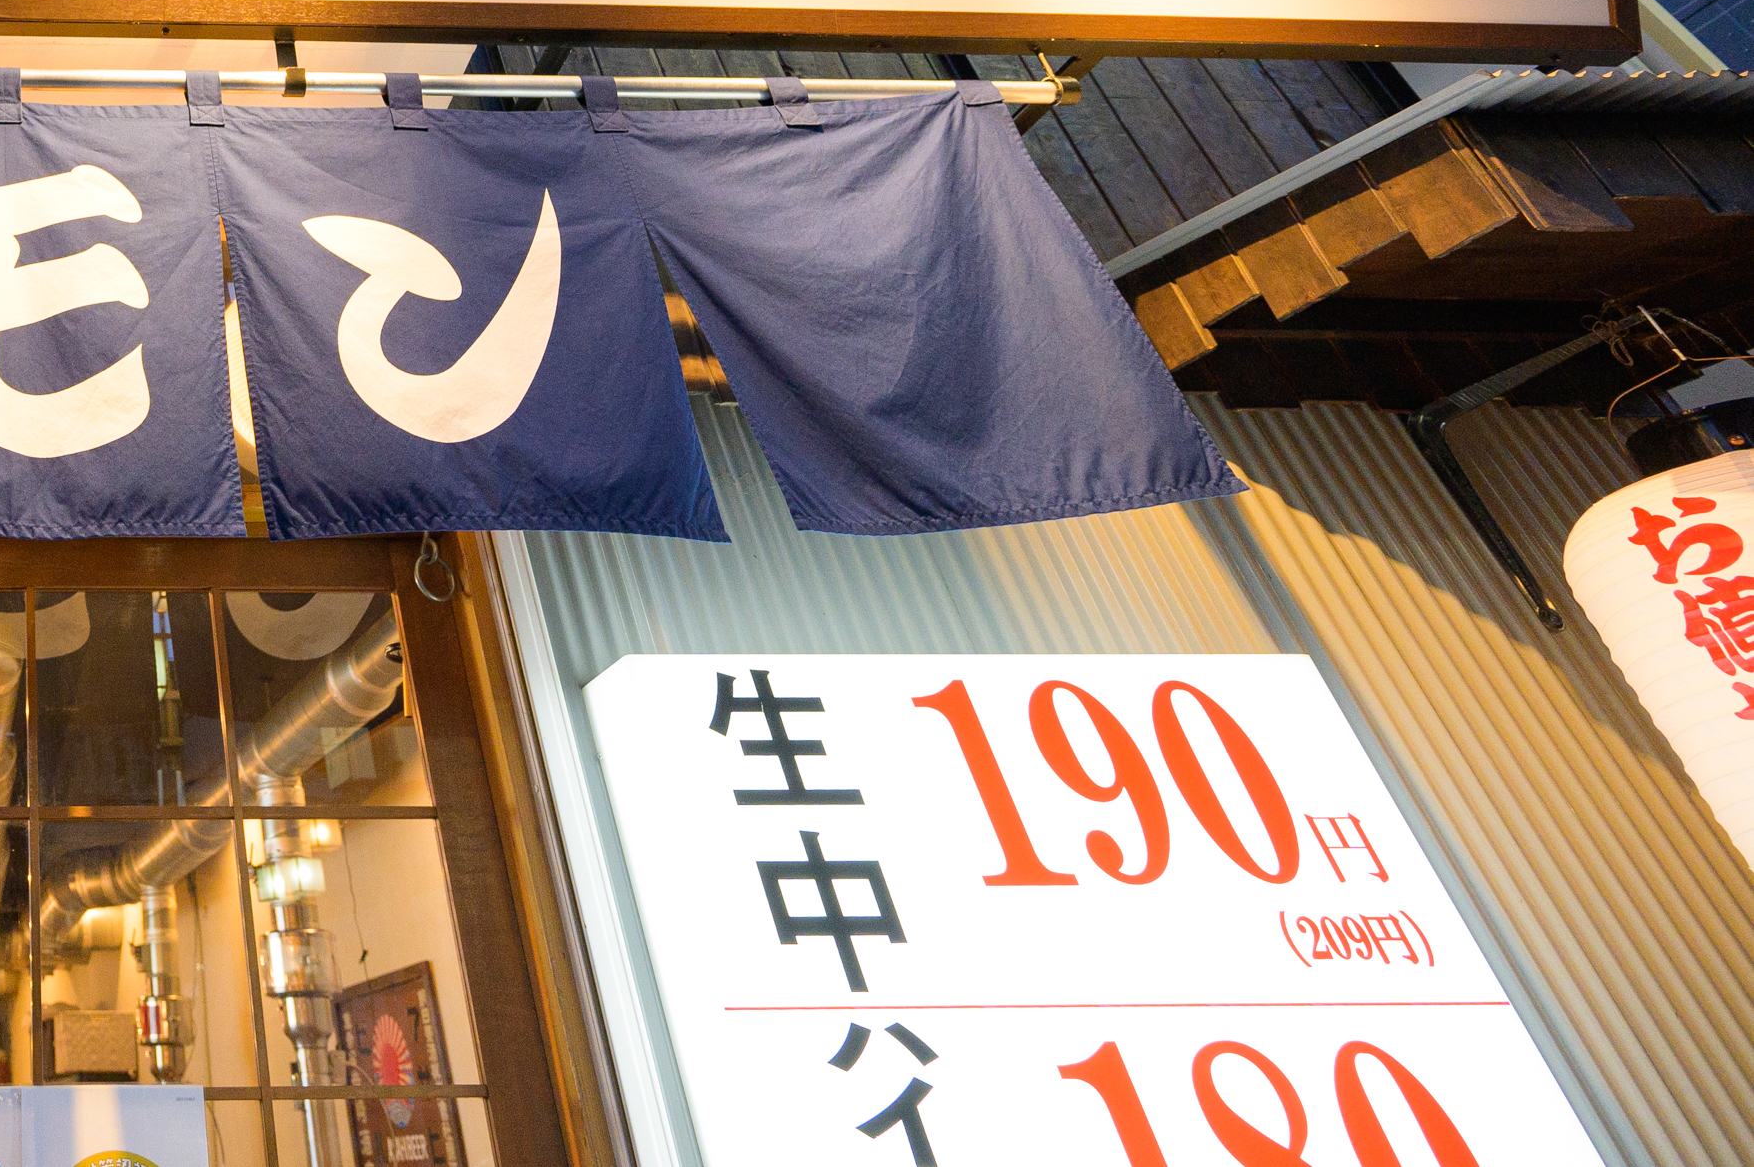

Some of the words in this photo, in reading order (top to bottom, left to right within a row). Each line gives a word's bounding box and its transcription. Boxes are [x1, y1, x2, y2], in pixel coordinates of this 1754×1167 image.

[1627, 496, 1754, 720] お値
[709, 669, 907, 993] 生中
[1279, 910, 1435, 968] (209円)
